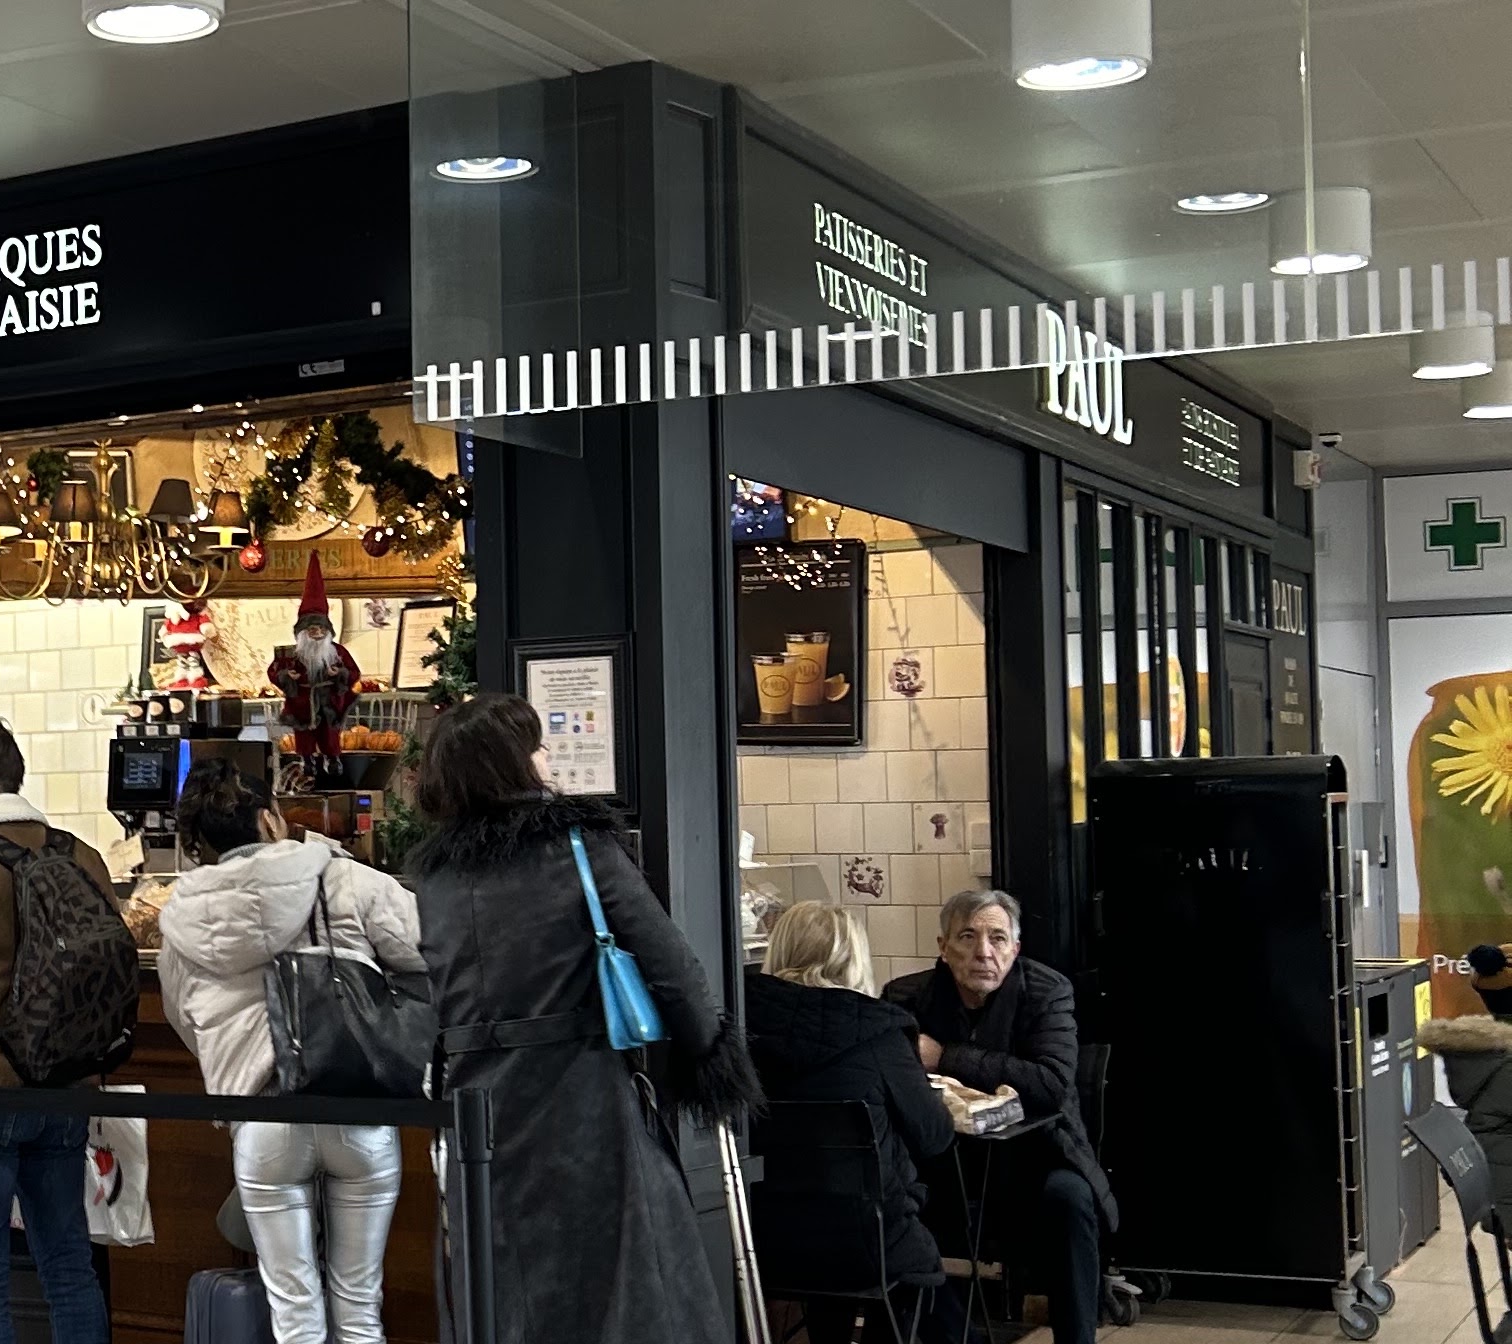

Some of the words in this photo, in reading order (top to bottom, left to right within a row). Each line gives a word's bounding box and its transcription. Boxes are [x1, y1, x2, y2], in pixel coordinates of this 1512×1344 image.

[814, 202, 907, 286] PATISSERIES
[909, 254, 928, 297] ET
[1046, 309, 1134, 445] PAUL
[1272, 579, 1307, 636] PAUL
